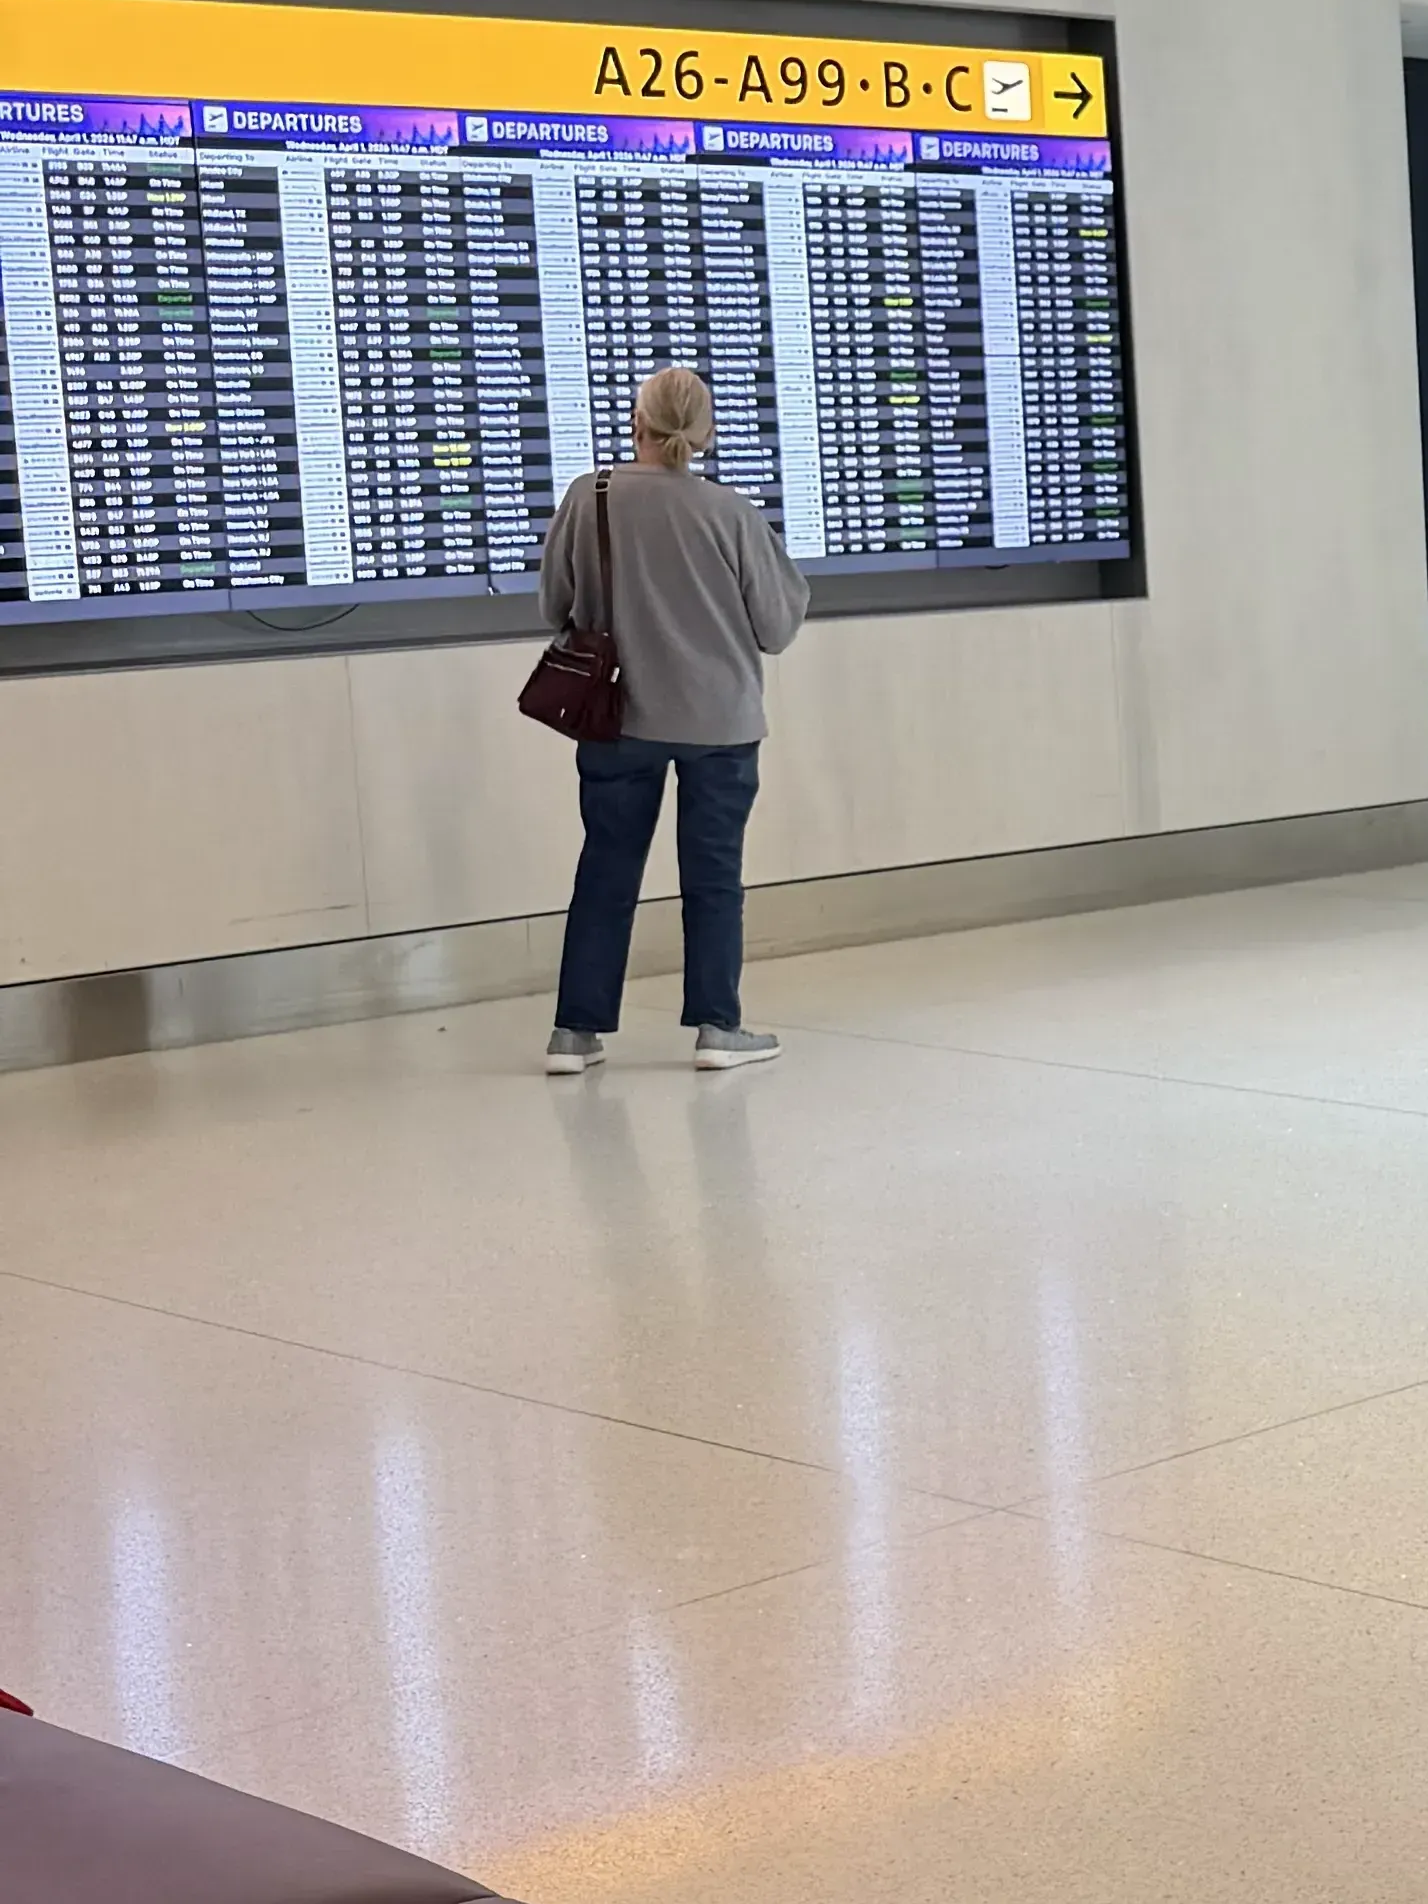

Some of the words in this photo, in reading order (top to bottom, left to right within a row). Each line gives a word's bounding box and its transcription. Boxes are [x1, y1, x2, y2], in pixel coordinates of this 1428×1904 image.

[233, 111, 363, 133] DEPARTURES
[492, 121, 609, 143] DEPARTURES
[727, 131, 834, 152] DEPARTURES
[943, 141, 1040, 161] DEPARTURES
